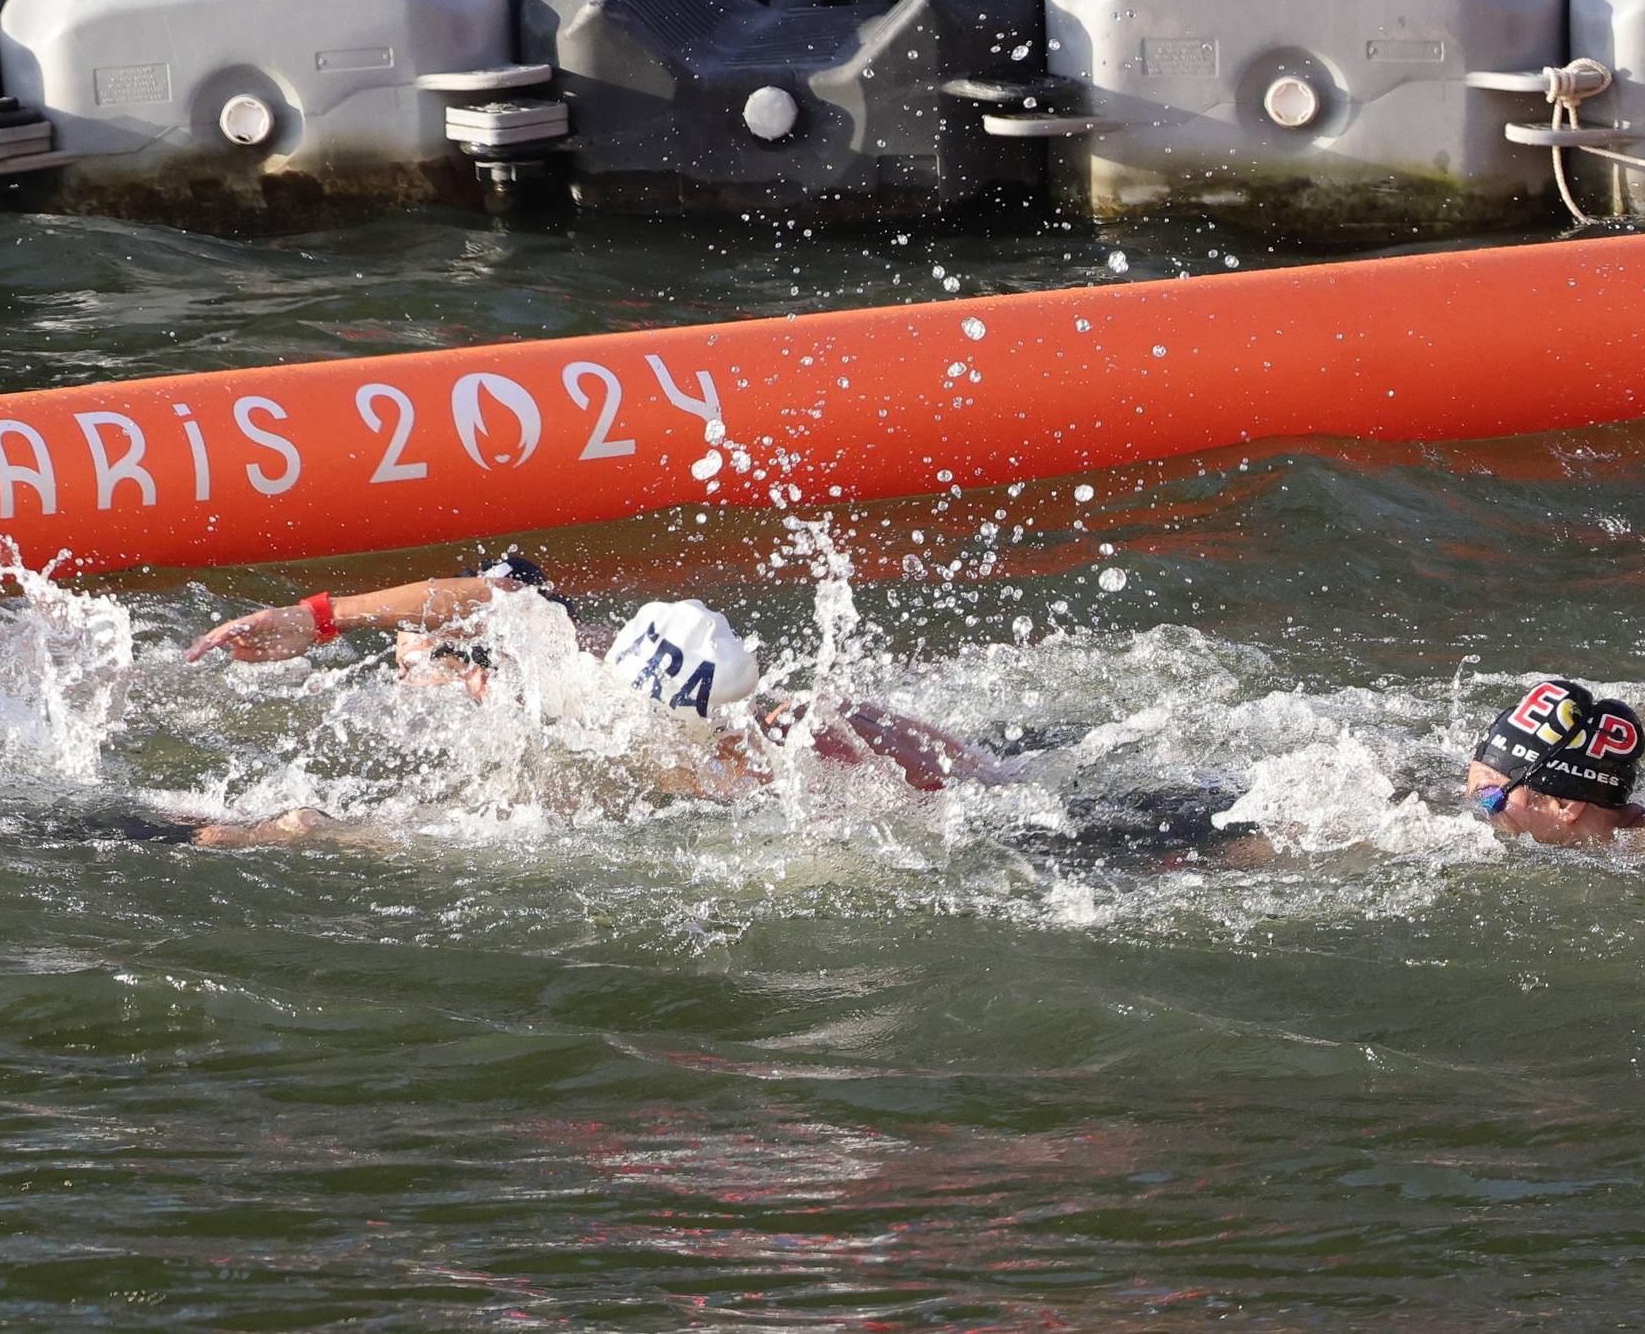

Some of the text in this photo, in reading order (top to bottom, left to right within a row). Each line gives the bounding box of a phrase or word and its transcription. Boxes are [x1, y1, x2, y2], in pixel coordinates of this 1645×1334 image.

[356, 354, 721, 483] 2024
[1491, 734, 1508, 751] M.
[1511, 743, 1540, 763] DE
[1508, 682, 1638, 760] ESP
